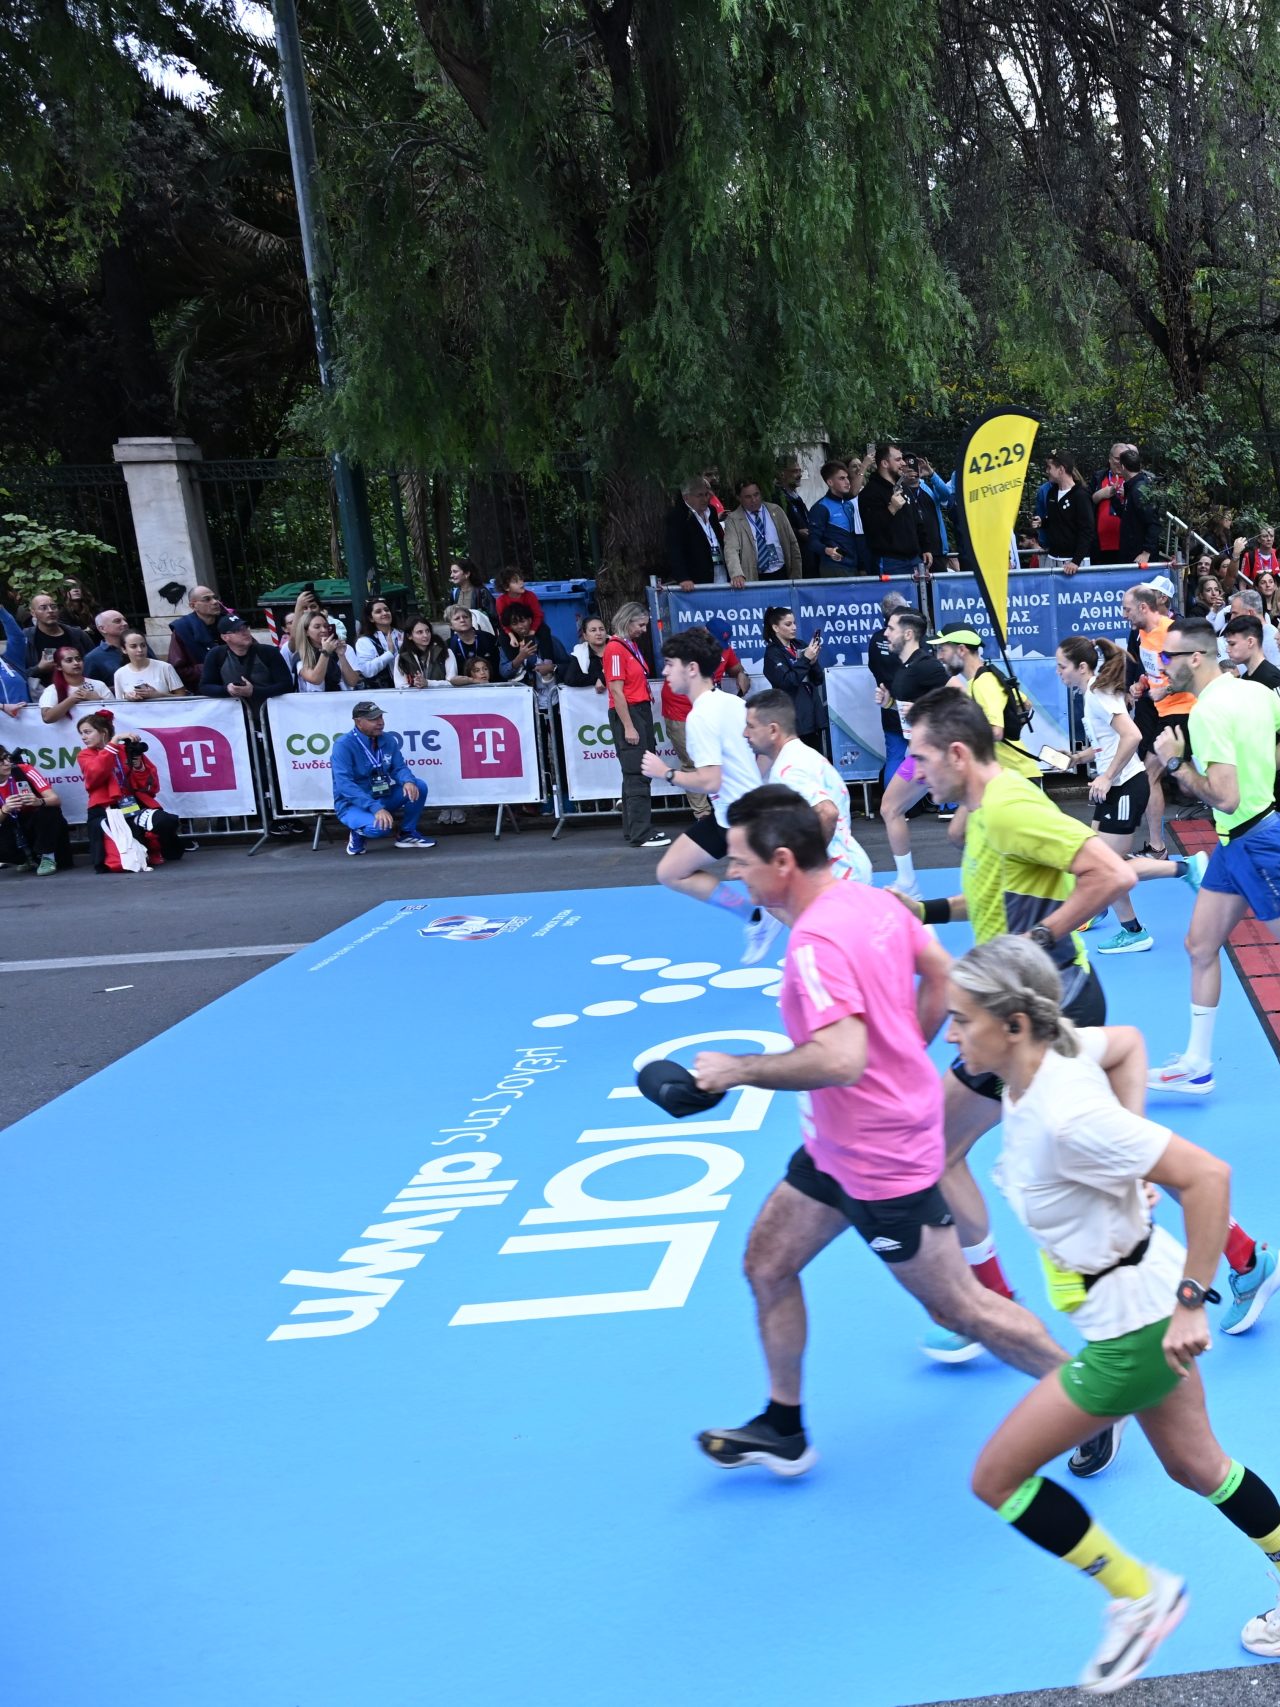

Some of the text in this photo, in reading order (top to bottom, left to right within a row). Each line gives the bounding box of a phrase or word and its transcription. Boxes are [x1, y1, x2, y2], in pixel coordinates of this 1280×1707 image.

[969, 443, 1025, 475] 42:29
[980, 477, 1022, 498] Piraeus
[1058, 590, 1124, 605] ΜΑΡΑΘΩ
[678, 606, 792, 623] ΜΑΡΑΘΩΝ
[1079, 605, 1123, 619] ΑΘΗΝ
[823, 618, 886, 633] ΑΘΗΝΑ
[1083, 621, 1132, 632] ΑΥΘΕΝΤΙ
[266, 1151, 519, 1342] allwyn
